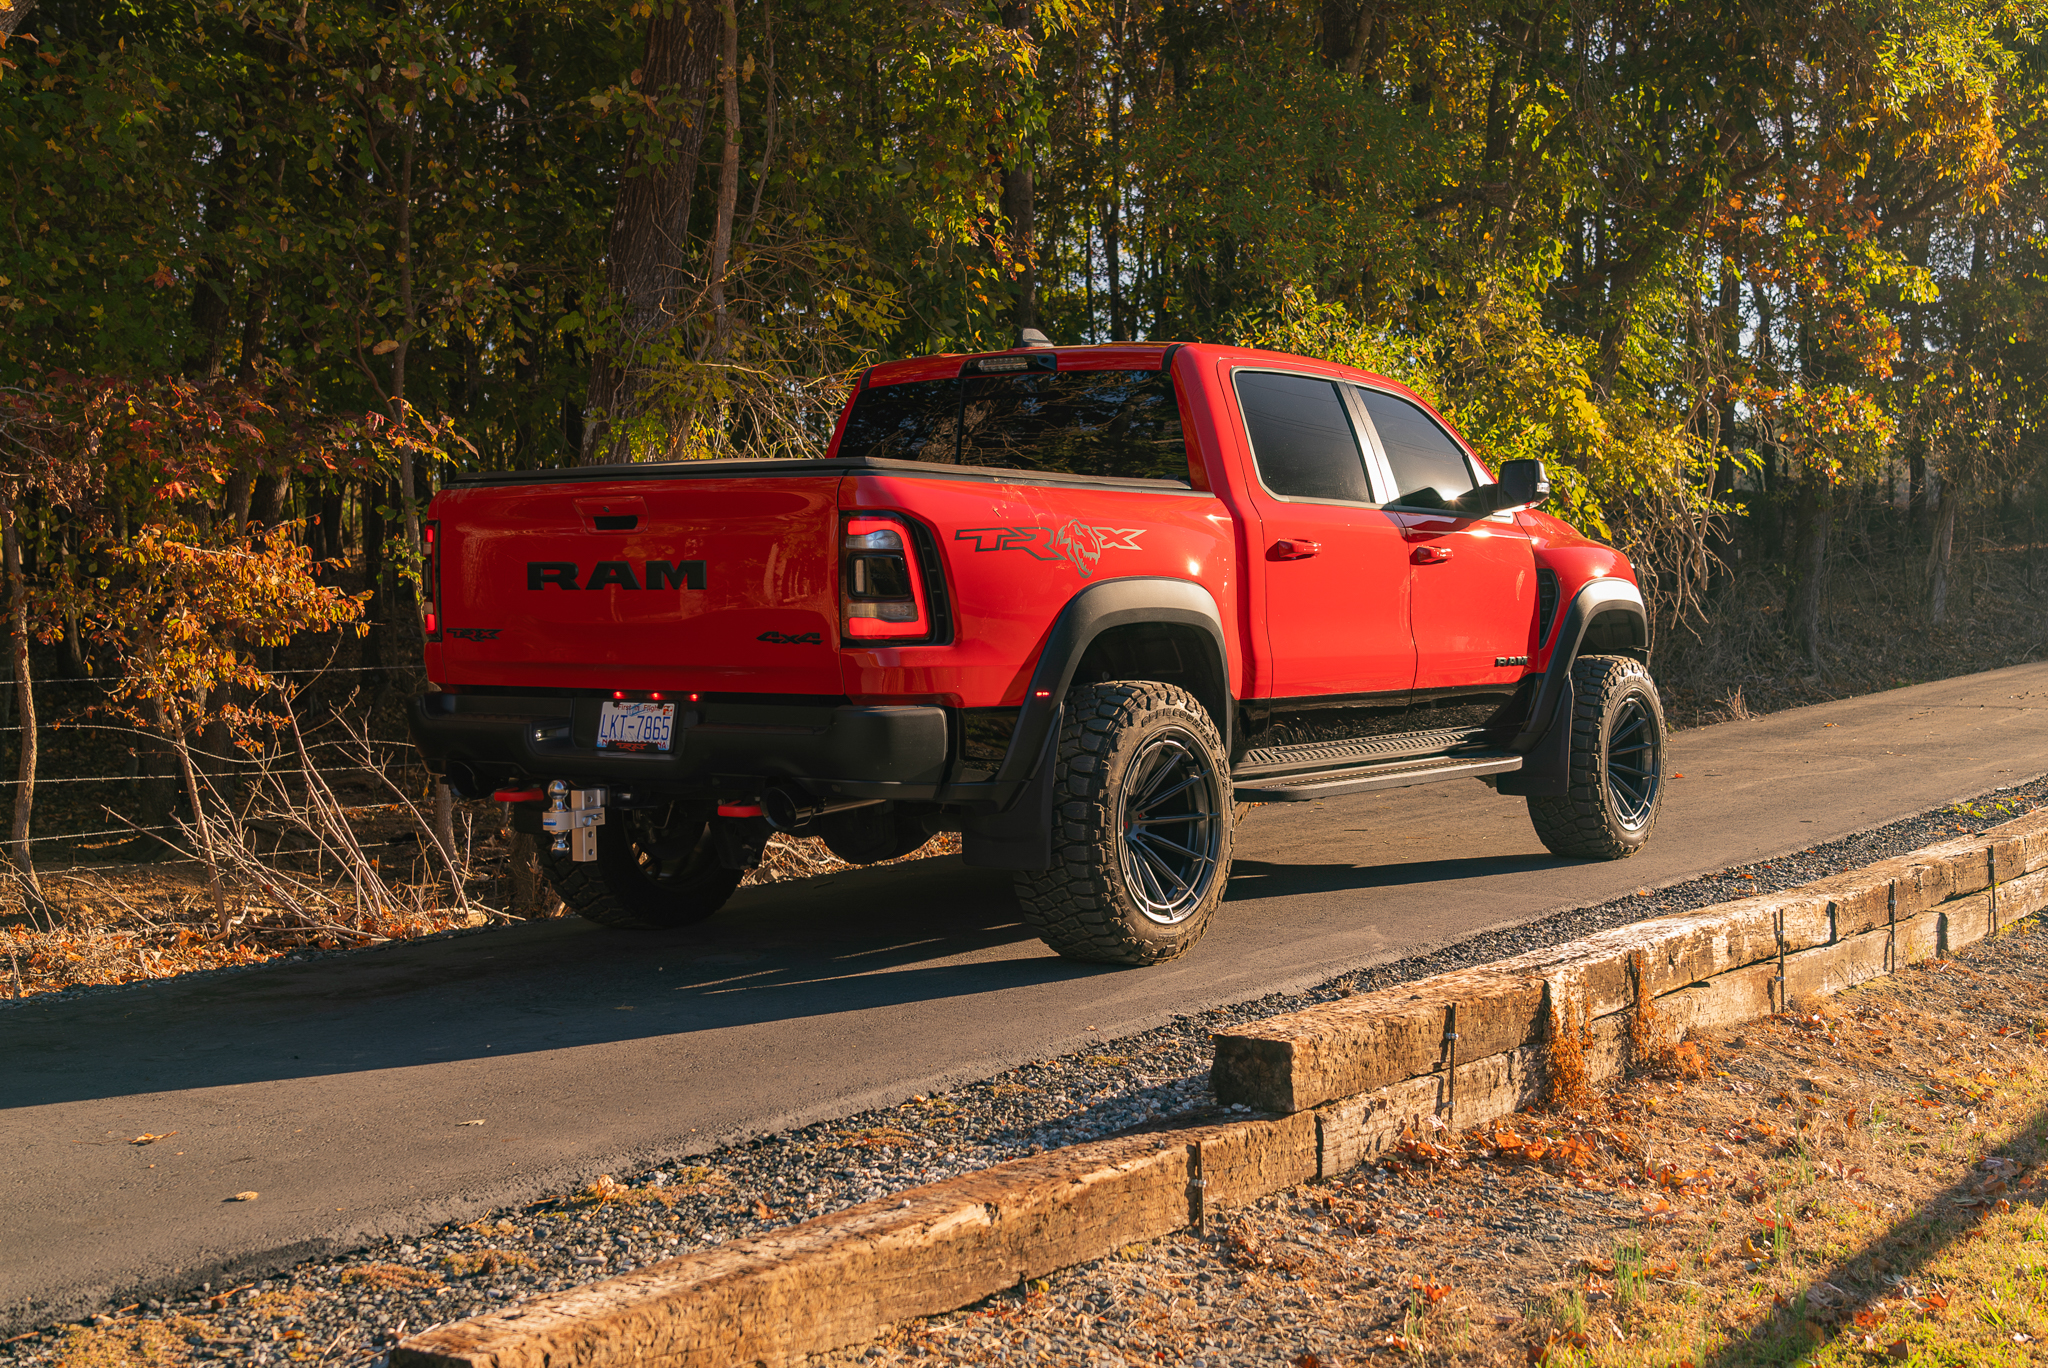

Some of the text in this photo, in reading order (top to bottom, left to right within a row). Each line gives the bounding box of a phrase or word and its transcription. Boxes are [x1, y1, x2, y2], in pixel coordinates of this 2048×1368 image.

[954, 526, 1147, 561] TRX
[527, 560, 707, 591] RAM
[446, 628, 504, 642] TRX
[756, 631, 825, 645] 4x4
[1494, 656, 1528, 667] RAM
[600, 713, 671, 741] LKT-7865
[616, 742, 648, 752] TRX
